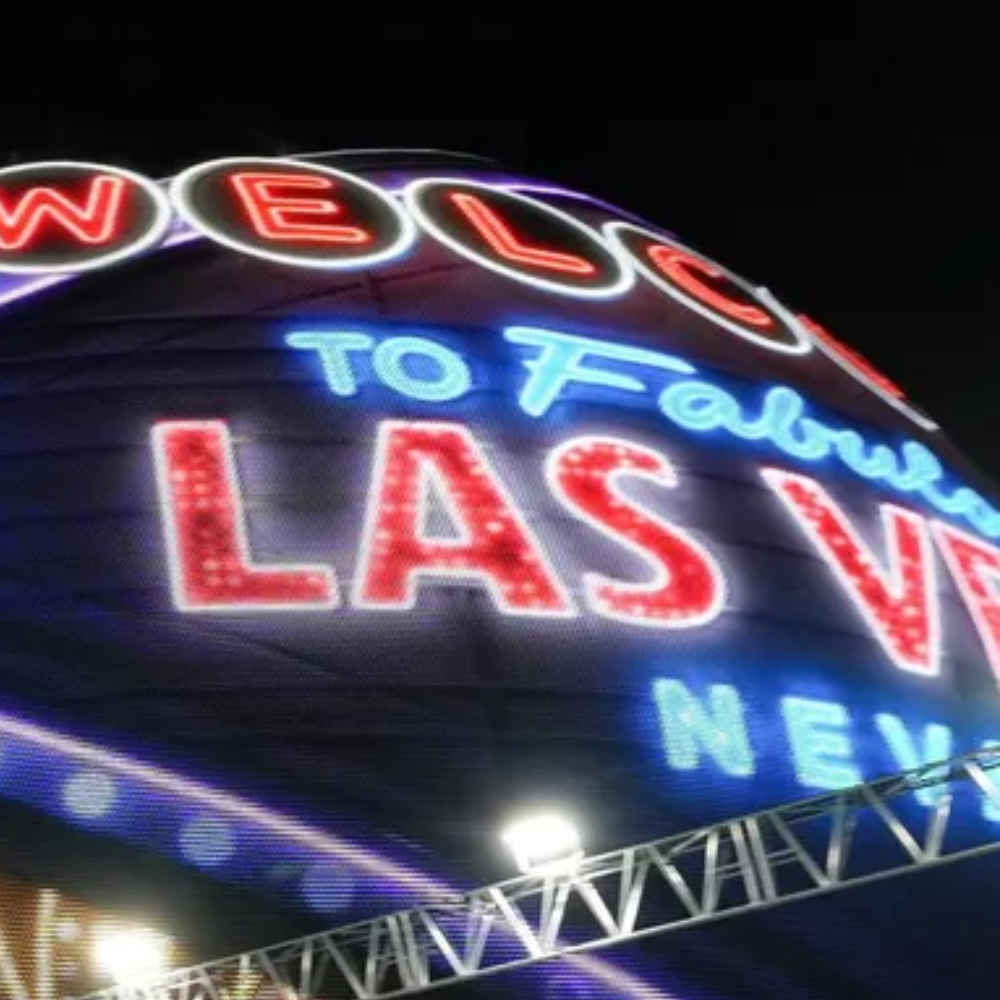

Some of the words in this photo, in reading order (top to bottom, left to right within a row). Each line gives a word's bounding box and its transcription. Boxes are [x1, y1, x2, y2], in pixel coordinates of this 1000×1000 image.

[284, 331, 472, 402] TO
[150, 418, 728, 628] LAS
[652, 677, 1000, 820] NEV
